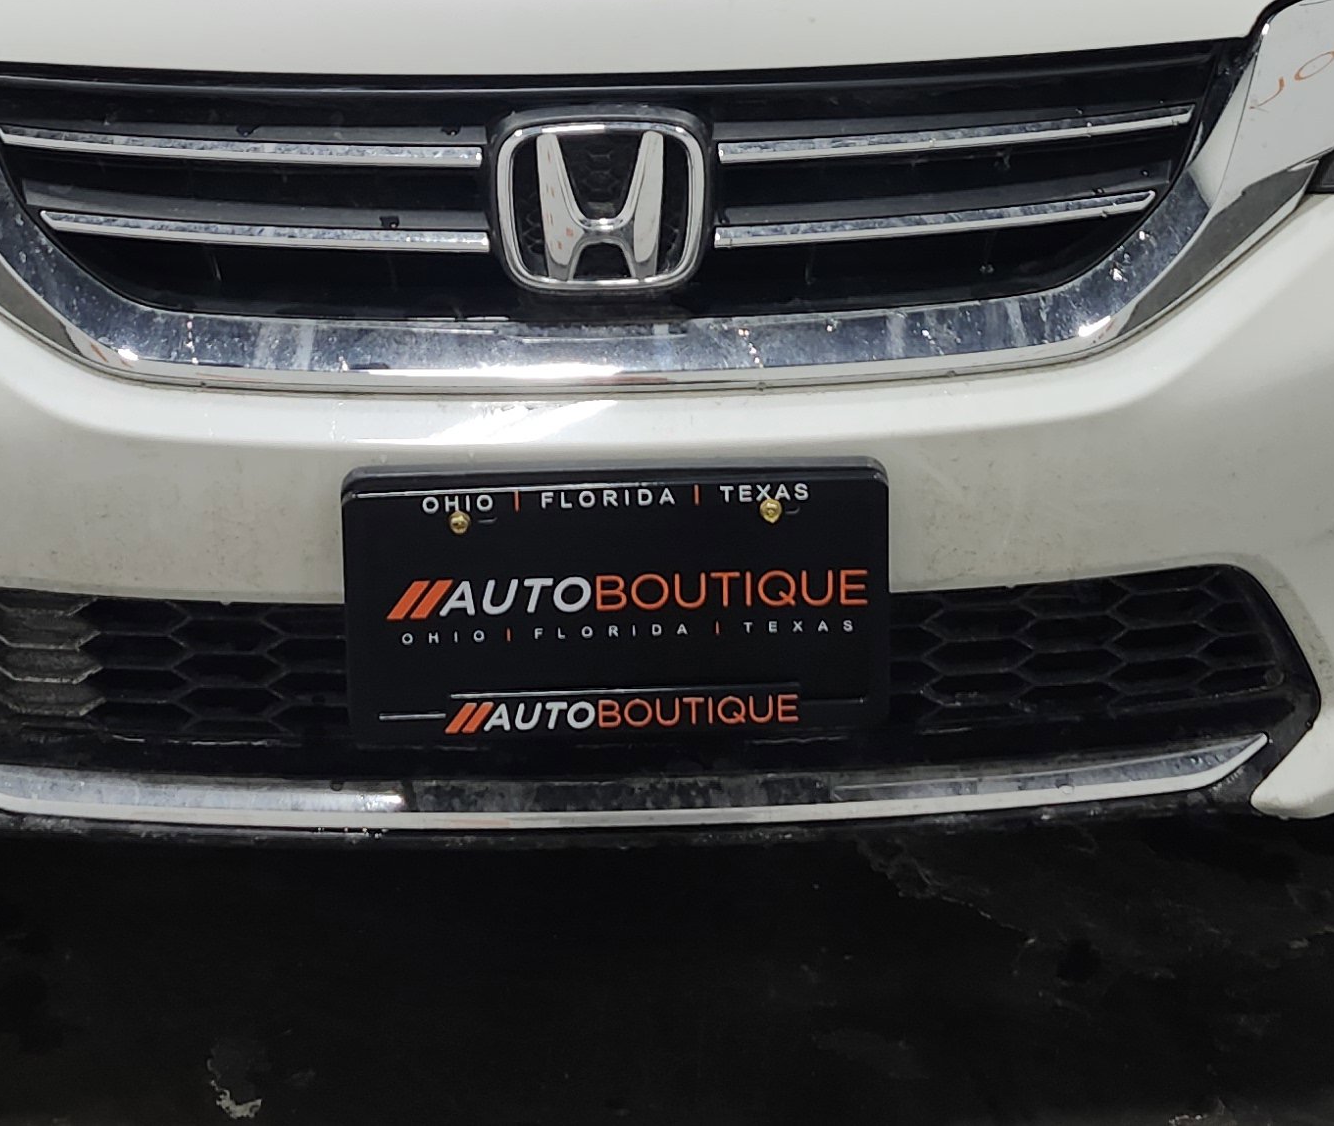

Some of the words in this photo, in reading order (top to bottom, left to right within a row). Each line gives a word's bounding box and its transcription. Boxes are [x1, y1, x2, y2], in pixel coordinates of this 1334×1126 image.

[422, 494, 493, 515] OHIO
[541, 488, 676, 509] FLORIDA
[719, 482, 809, 503] TEXAS
[440, 569, 868, 617] AUTOBOUTIQUE
[401, 629, 485, 645] OHIO
[534, 622, 688, 640] FLORIDA
[743, 620, 854, 634] TEXAS
[484, 694, 799, 732] AUTOBOUTIQUE
